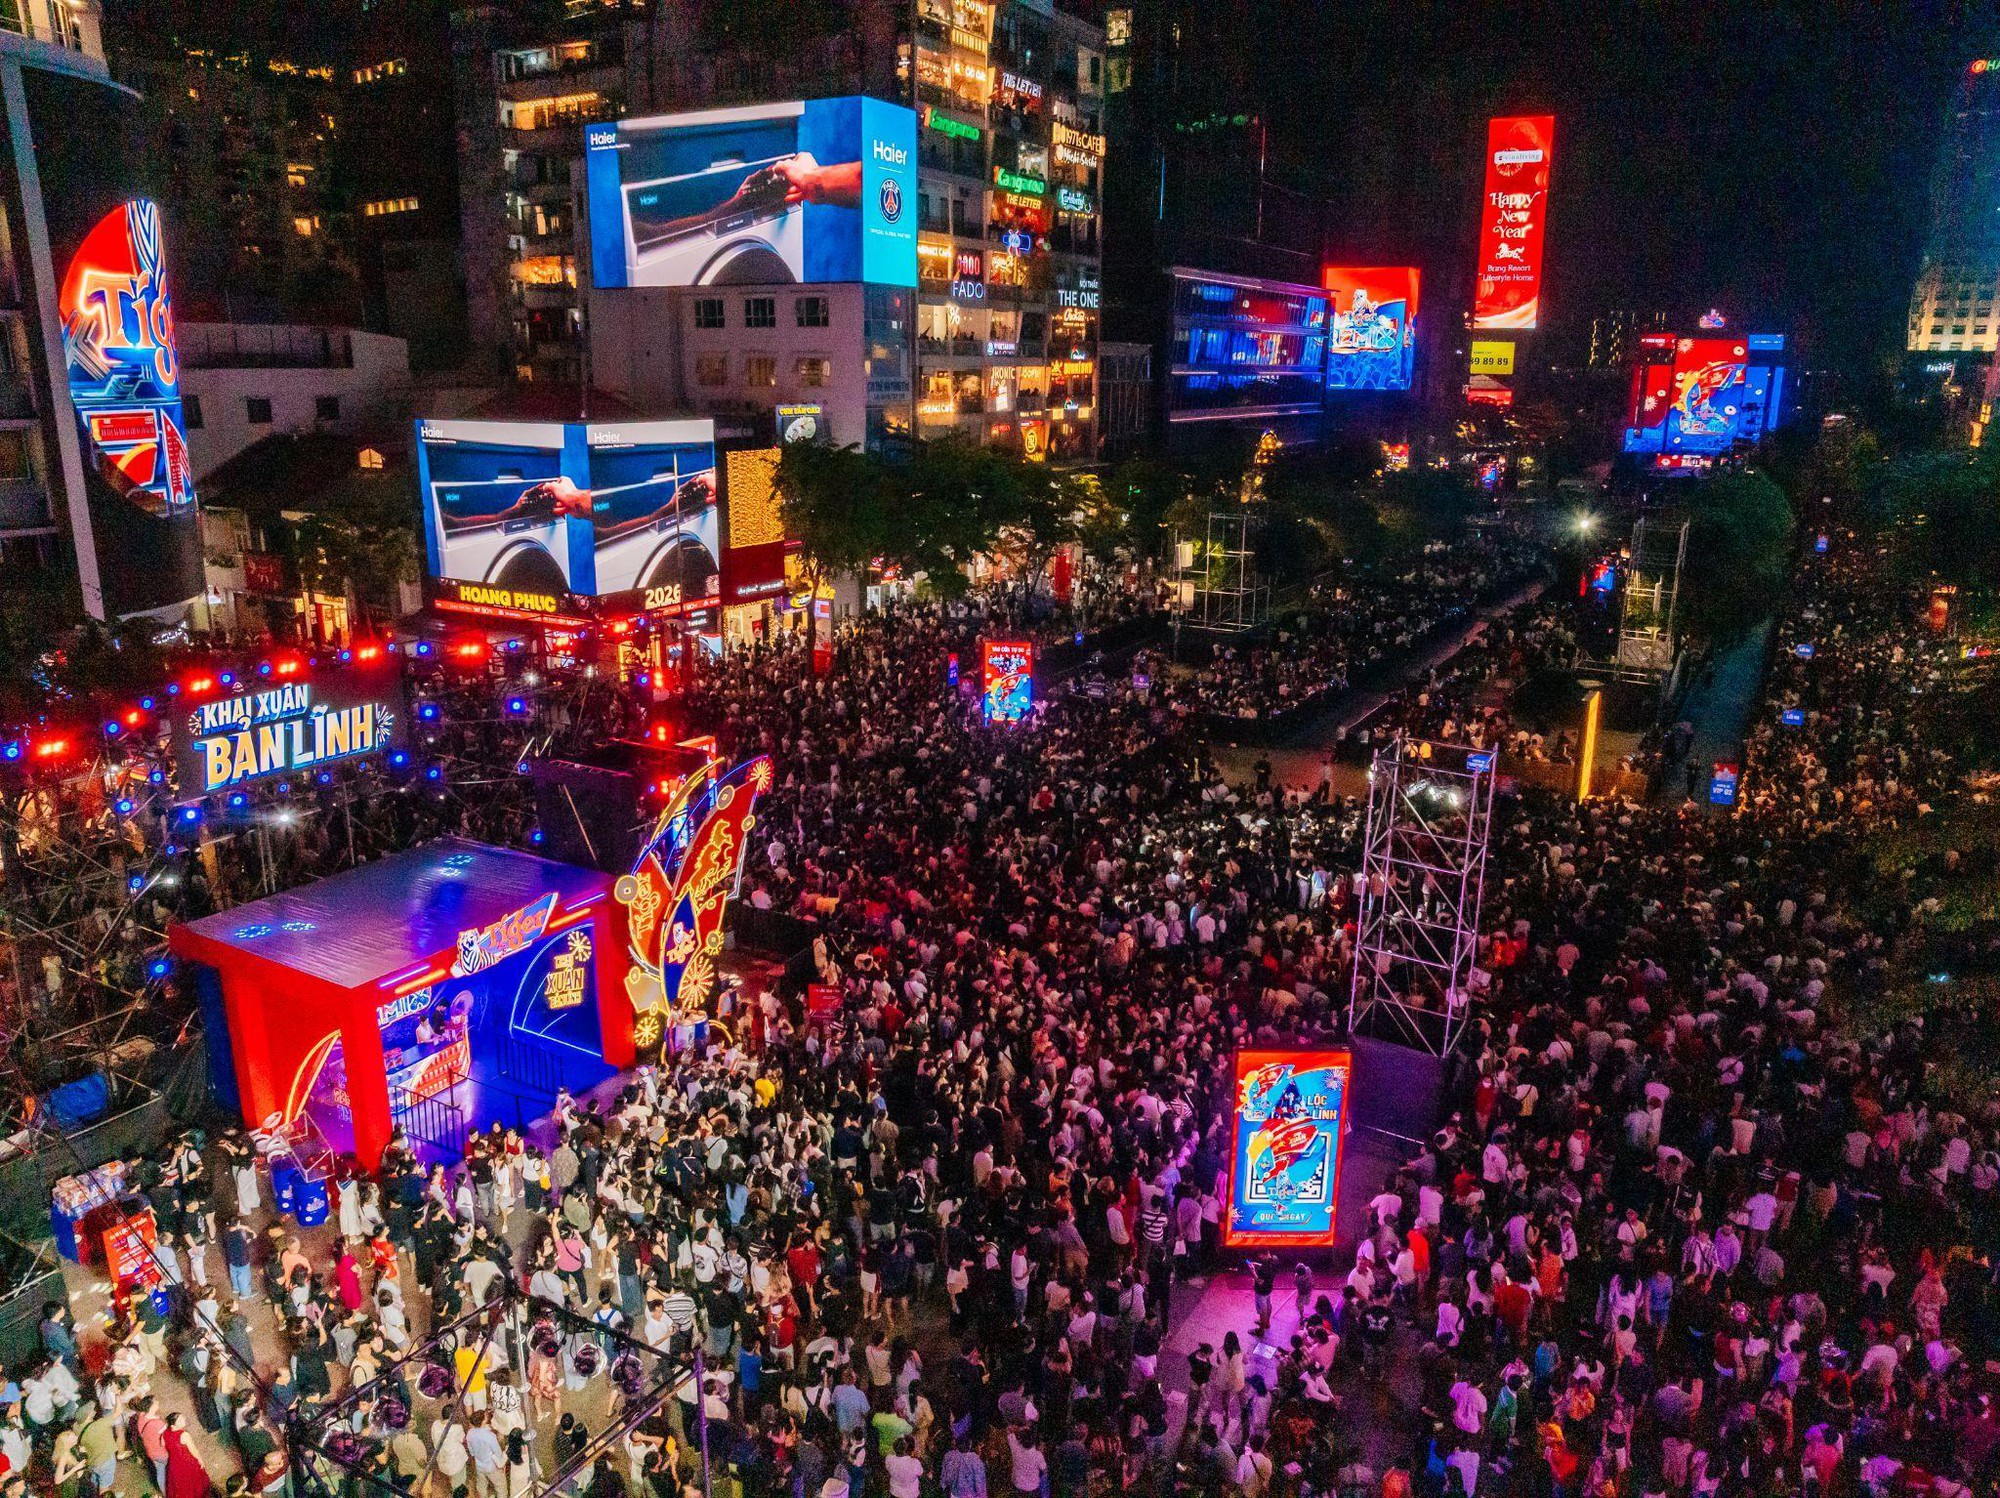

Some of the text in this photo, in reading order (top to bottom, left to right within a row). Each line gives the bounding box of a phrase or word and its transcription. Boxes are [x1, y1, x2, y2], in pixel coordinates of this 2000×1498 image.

[1002, 72, 1016, 89] THE
[1016, 76, 1042, 98] LETTER
[590, 131, 616, 145] Haier
[873, 139, 907, 166] Haier
[998, 168, 1046, 194] Kangaroo
[1006, 193, 1042, 210] THE LETTER
[1489, 191, 1541, 209] Happy
[1497, 210, 1529, 223] New
[1492, 223, 1534, 239] Year
[1512, 274, 1535, 282] Home
[953, 280, 984, 299] FADO
[1058, 289, 1099, 308] THE ONE
[80, 269, 178, 387] Tig
[1482, 357, 1495, 366] 89
[1497, 357, 1509, 366] 89
[421, 427, 444, 439] Haier
[594, 432, 621, 443] Haier
[459, 585, 512, 607] HOANG
[645, 583, 681, 610] 2026
[201, 682, 309, 733] KHAI XUÂN
[202, 704, 373, 788] BẢN LĨNH
[633, 873, 661, 939] Tiger
[484, 909, 548, 950] Tiger
[545, 966, 584, 994] XUÂN
[1307, 1094, 1327, 1106] LỘC
[1312, 1107, 1337, 1120] LĨNH
